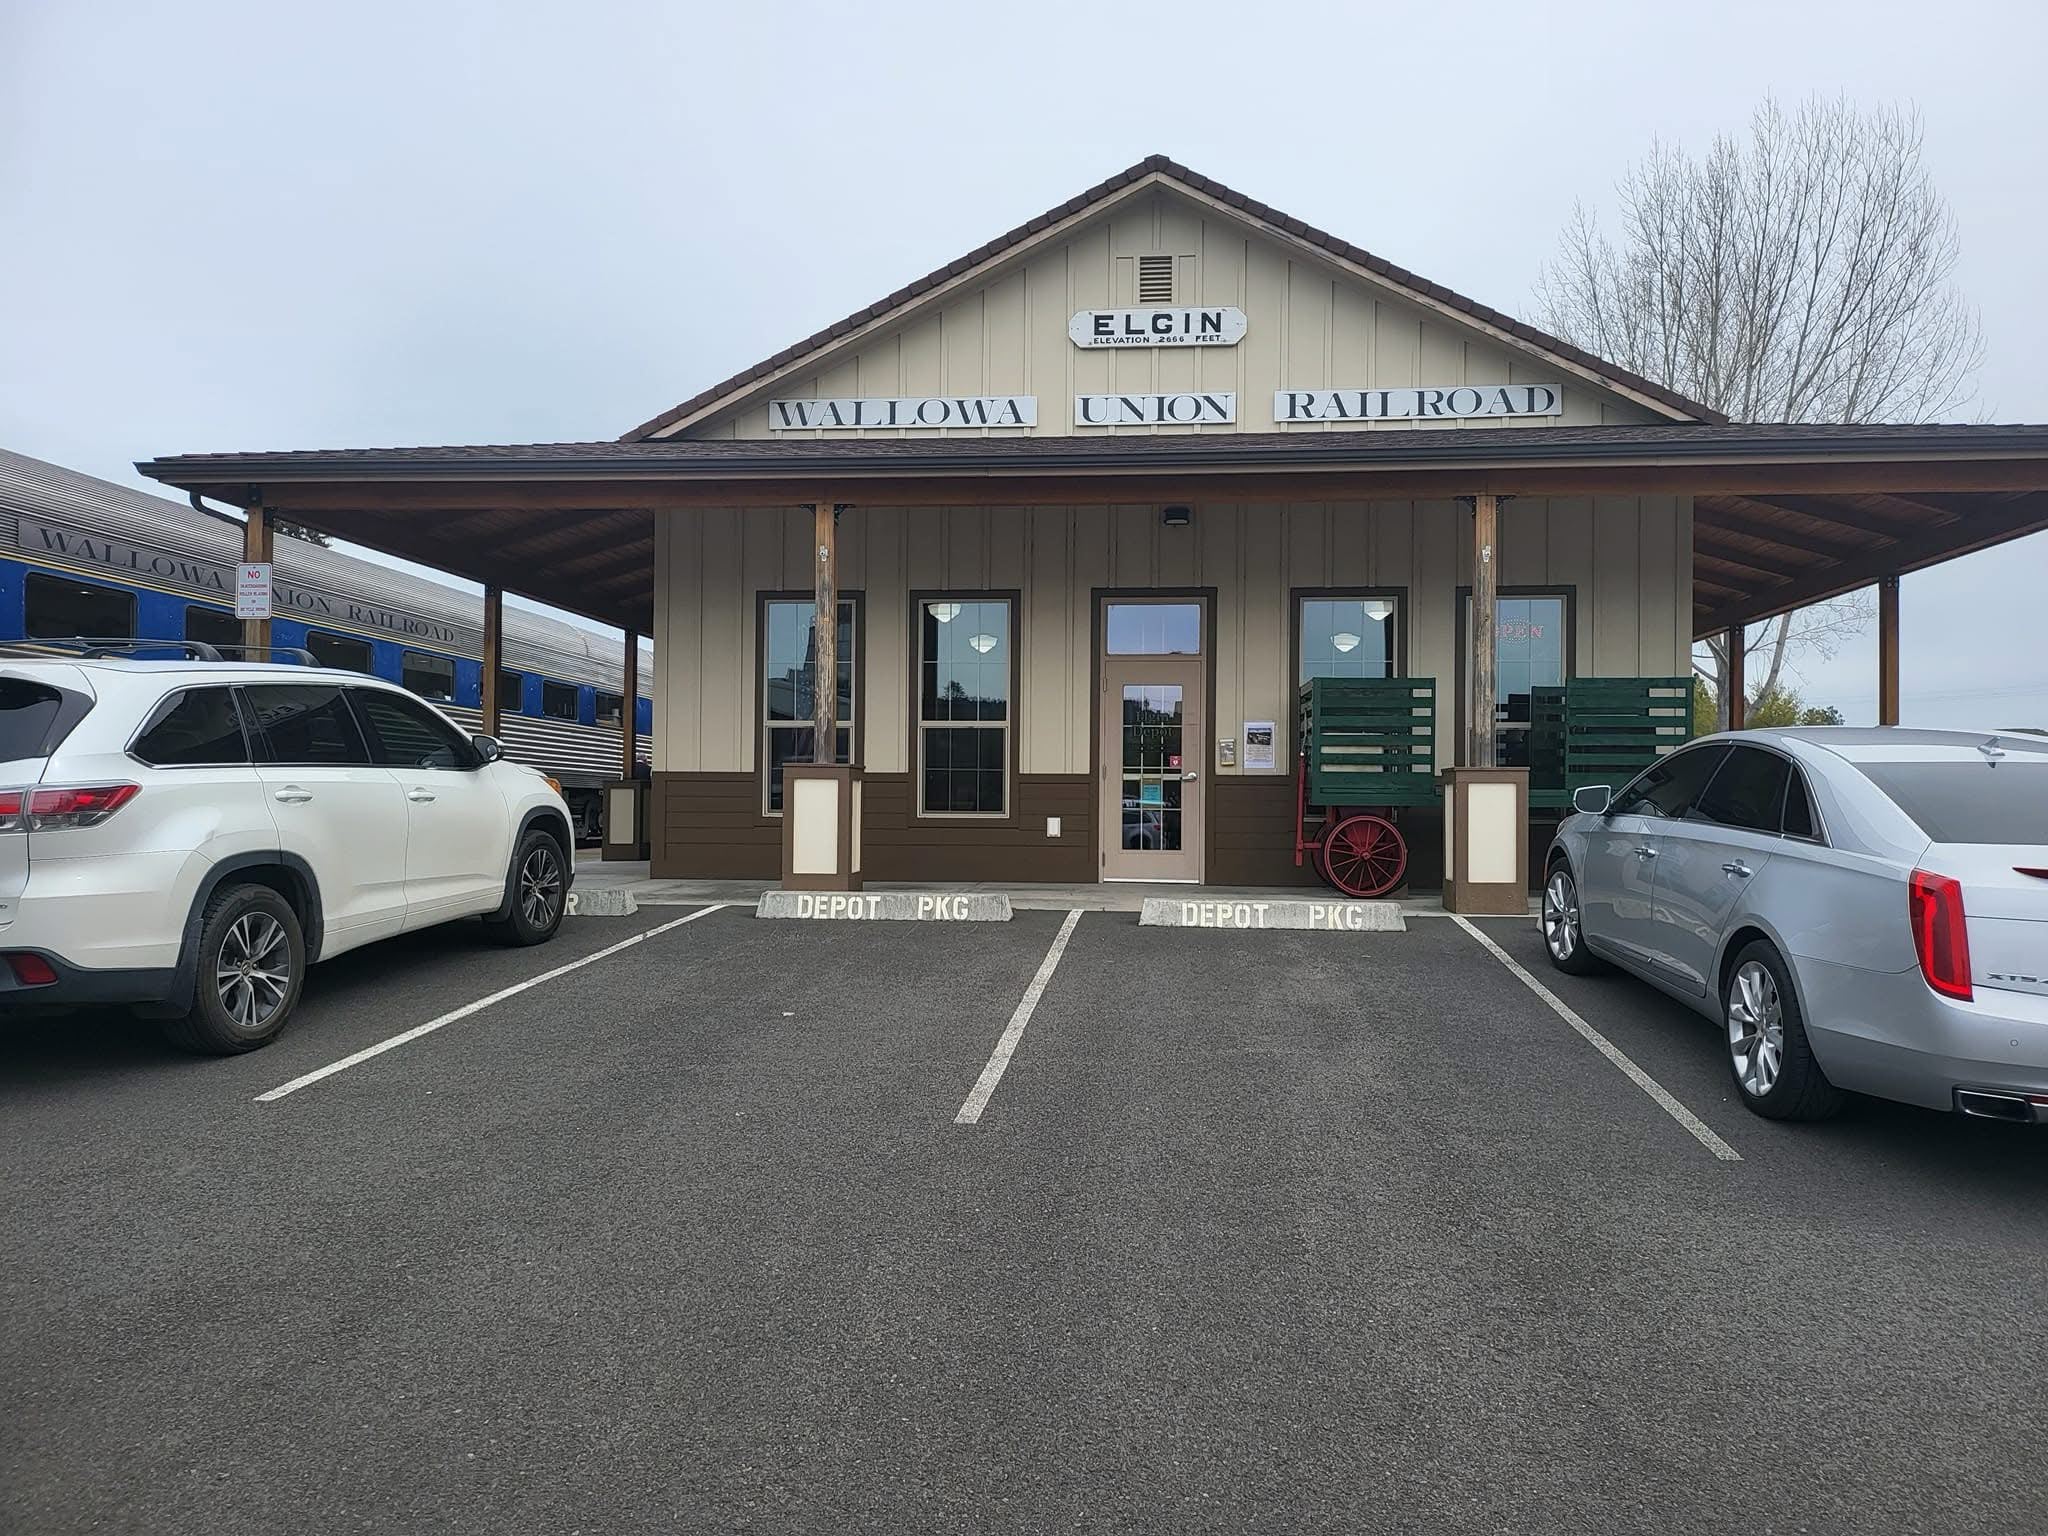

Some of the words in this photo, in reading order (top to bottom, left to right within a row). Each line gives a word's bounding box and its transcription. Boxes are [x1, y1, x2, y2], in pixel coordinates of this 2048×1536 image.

[1094, 312, 1222, 336] ELGIN
[1093, 336, 1150, 345] ELEVATION
[1158, 335, 1185, 343] 2666
[1195, 334, 1221, 342] FEET
[774, 398, 1028, 427] WALLOWA
[1078, 394, 1233, 423] UNION
[1284, 387, 1556, 419] RAILROAD
[39, 527, 225, 589] WALLOWA
[272, 586, 332, 614] NION
[348, 604, 455, 642] RAILROAD
[247, 570, 261, 579] NO
[797, 895, 882, 920] DEPOT
[917, 896, 970, 920] PKG
[1181, 902, 1269, 929] DEPOT
[1309, 904, 1363, 929] PKG
